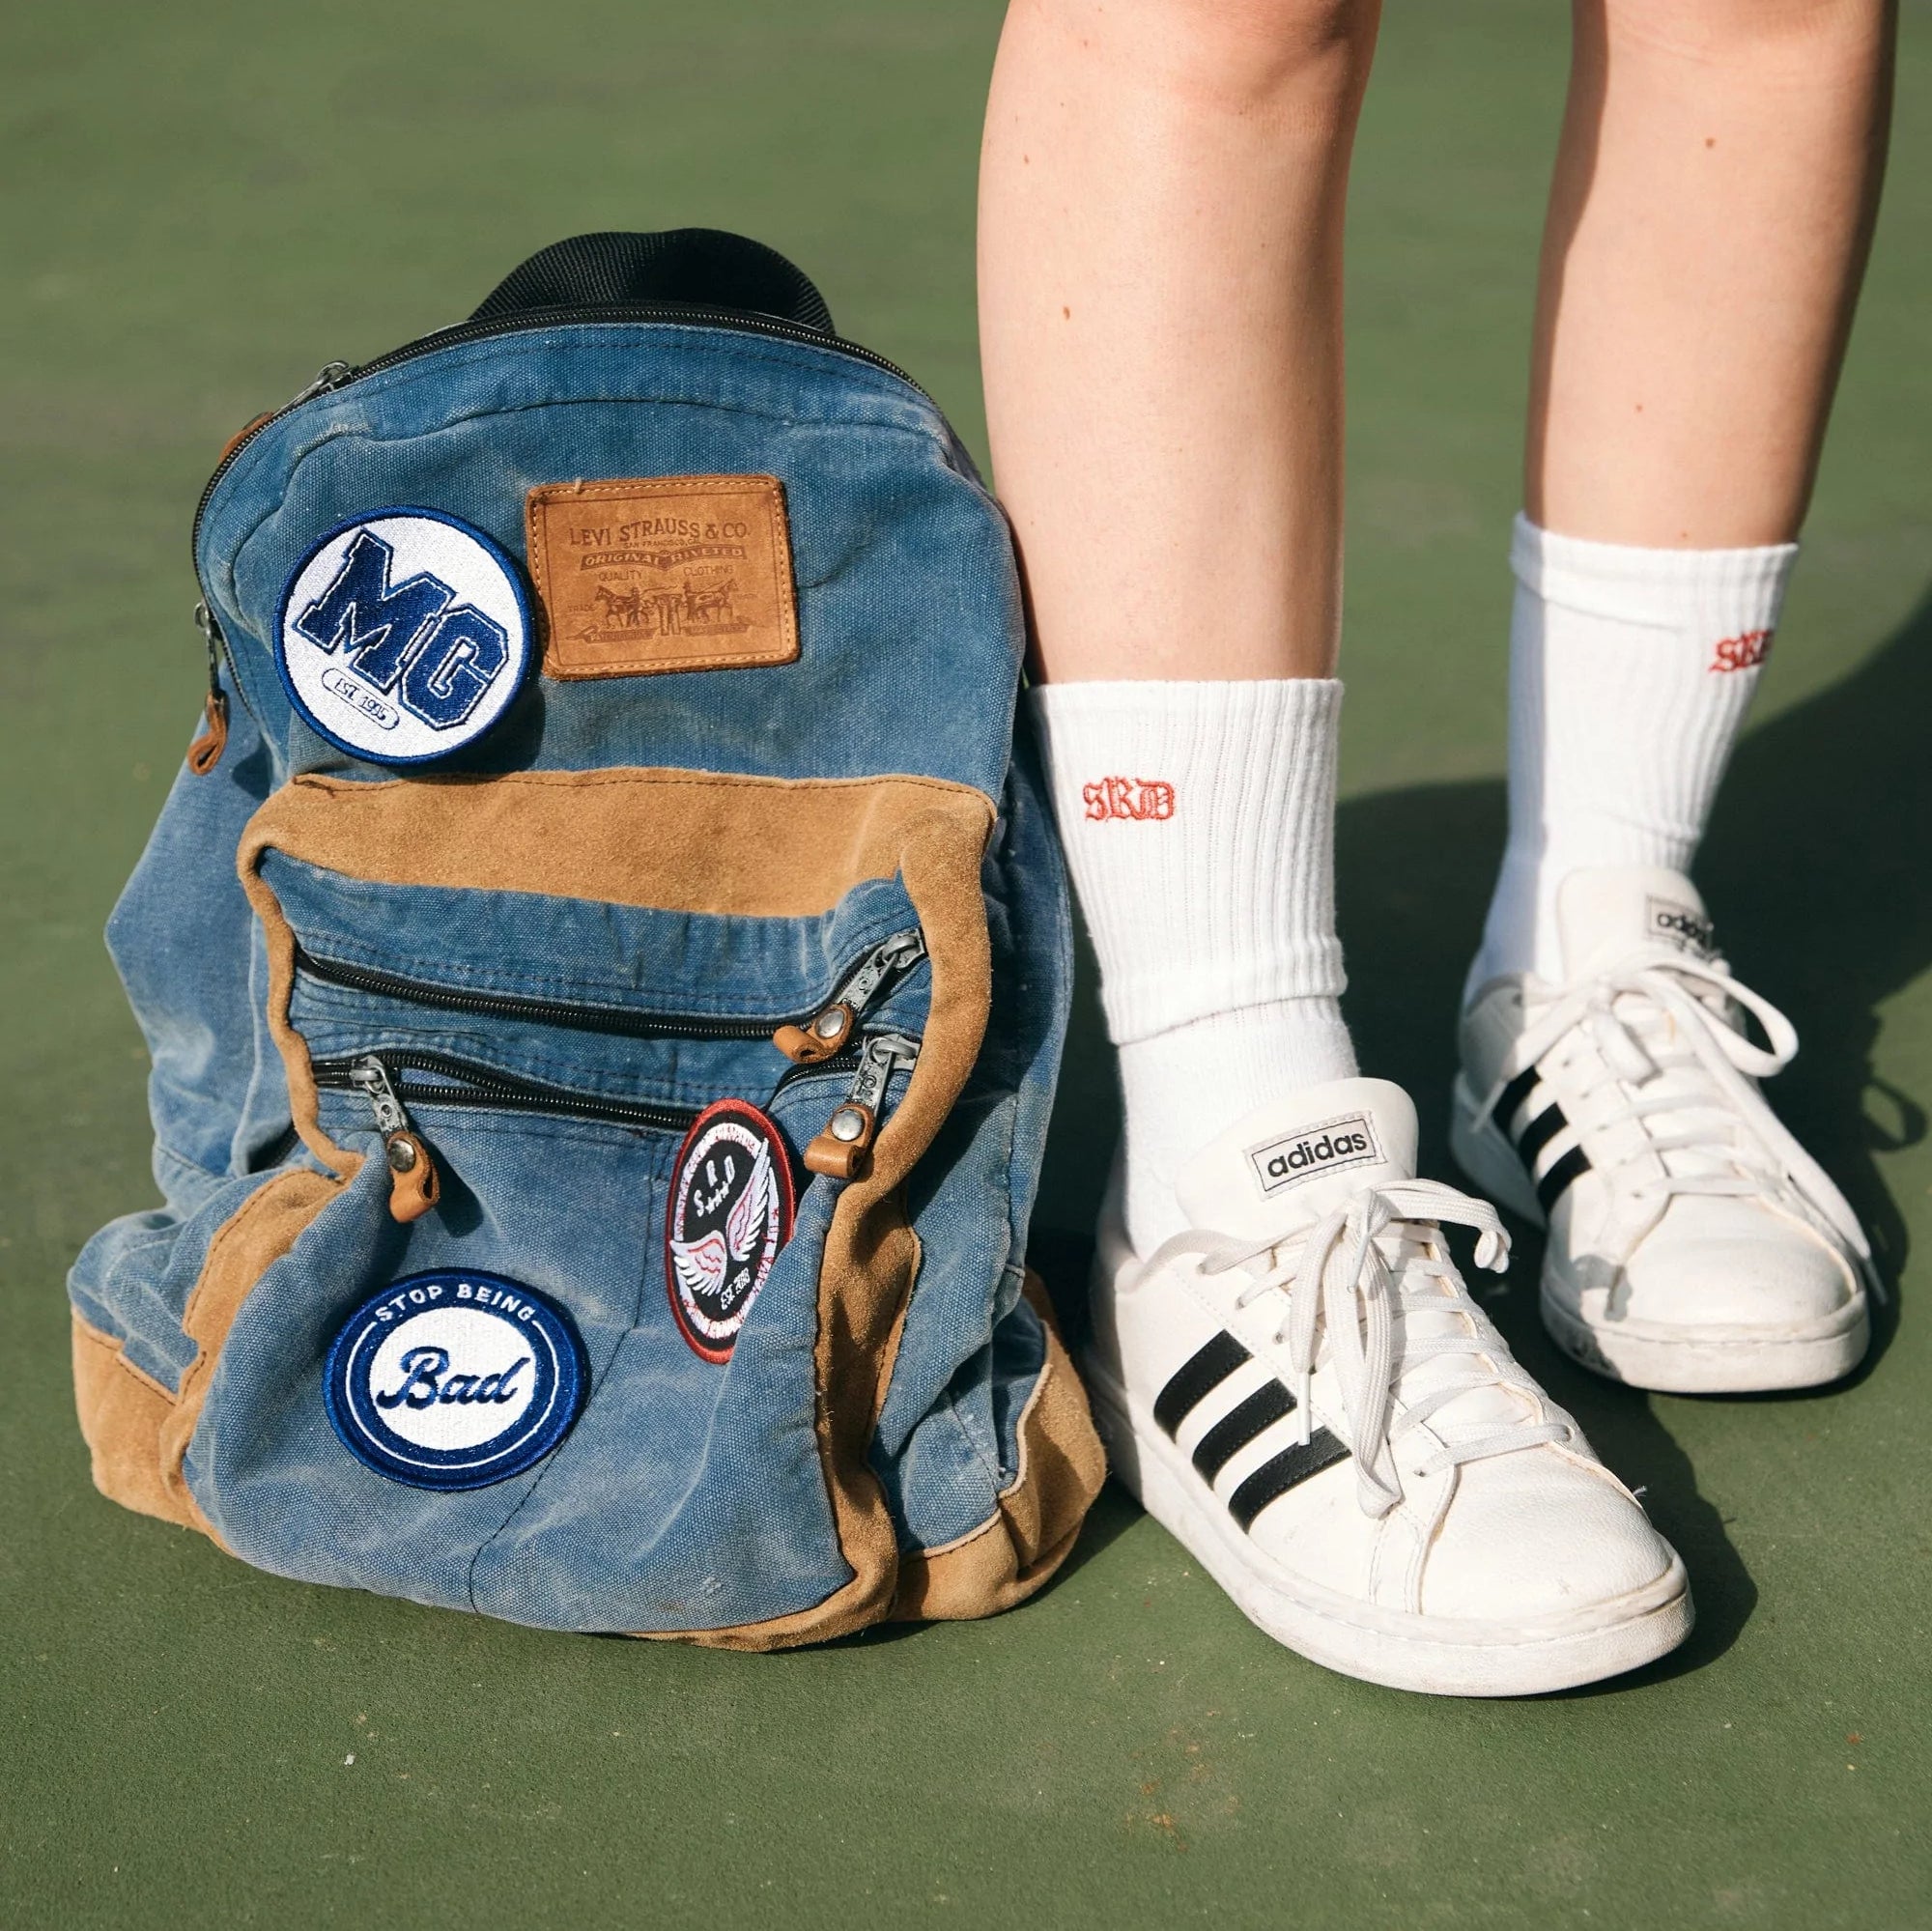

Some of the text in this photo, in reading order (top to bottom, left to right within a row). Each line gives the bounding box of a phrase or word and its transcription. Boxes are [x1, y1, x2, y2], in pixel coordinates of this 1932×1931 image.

[570, 526, 611, 547] LEVI
[619, 517, 700, 543] STRAUSS
[704, 524, 719, 540] &
[584, 548, 743, 567] ORIGINAL RIVETED
[598, 564, 735, 582] QUALITY CLOTHING
[293, 528, 510, 731] MG
[1267, 1133, 1367, 1178] adidas
[375, 1283, 536, 1322] STOP BEING
[376, 1346, 531, 1410] Bad
